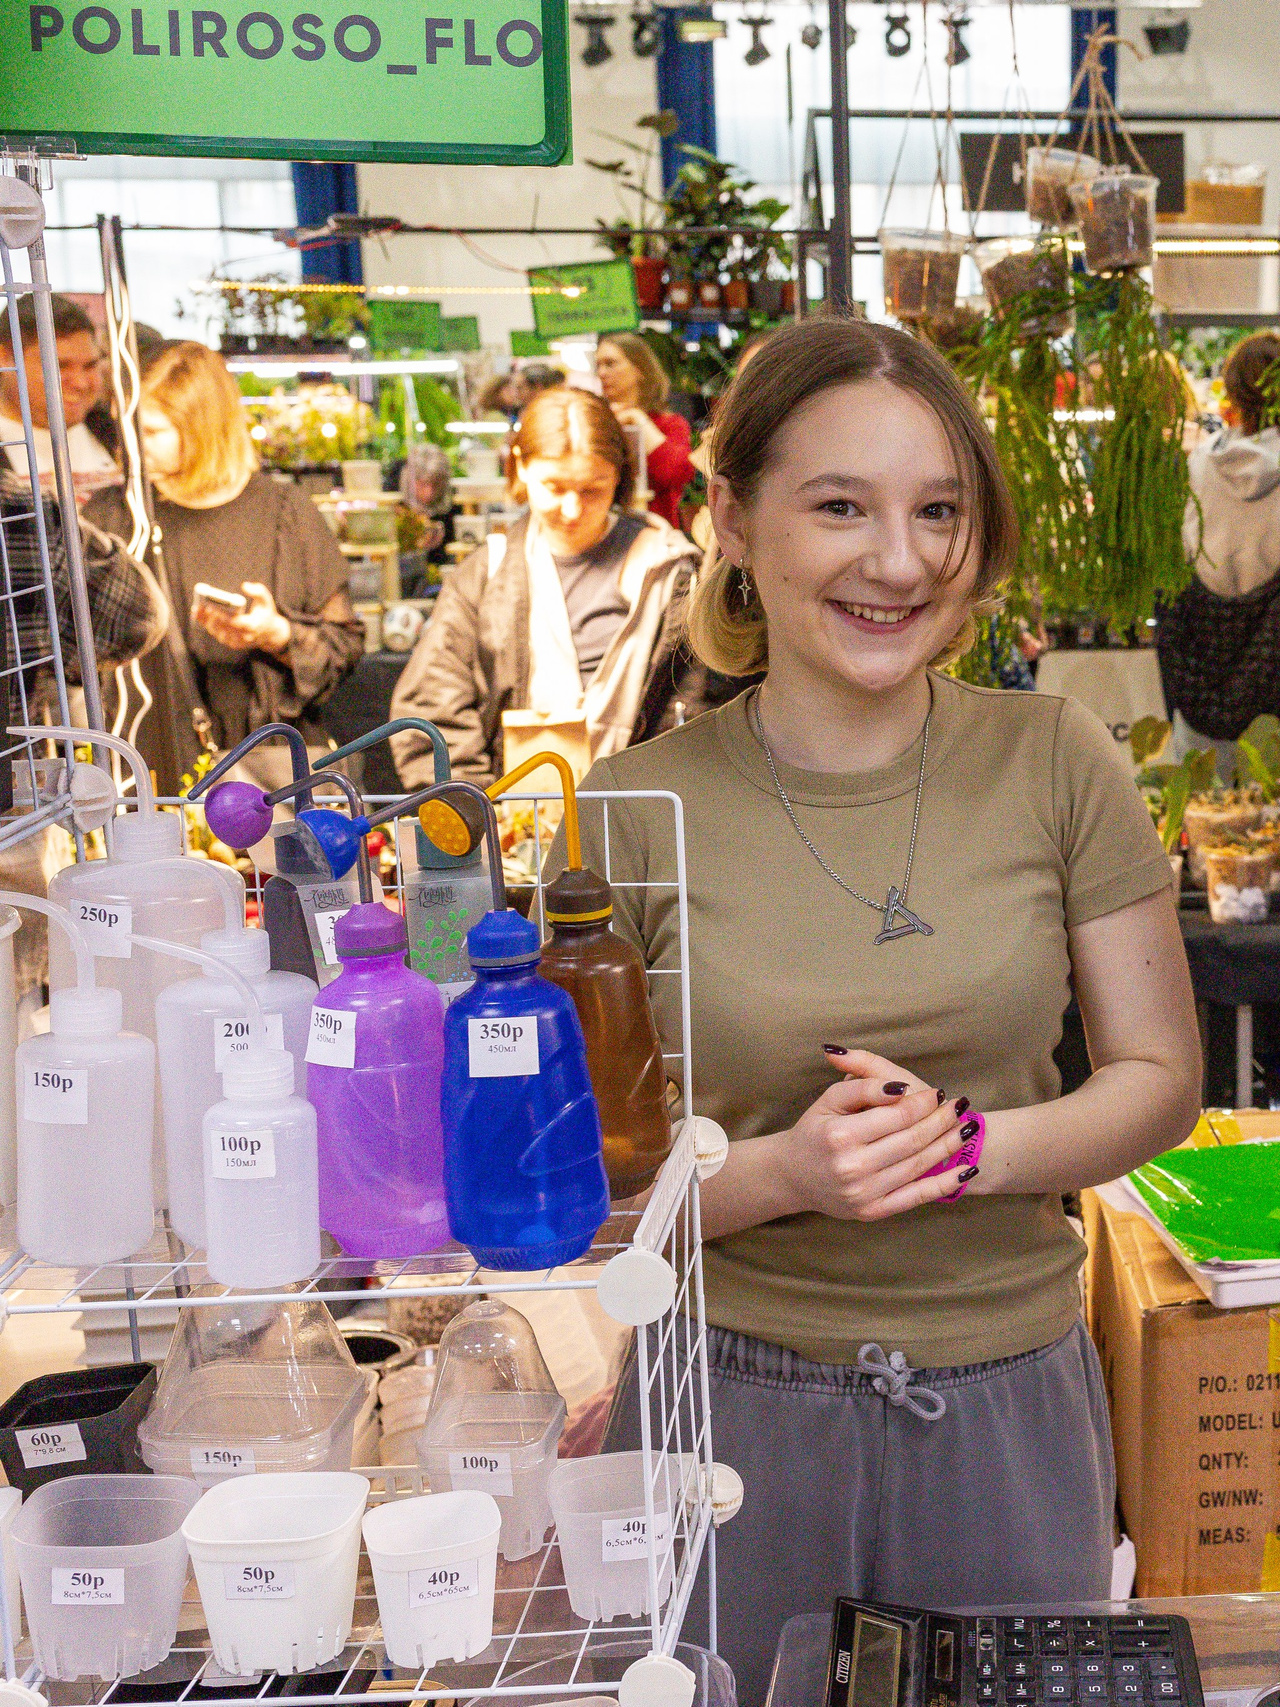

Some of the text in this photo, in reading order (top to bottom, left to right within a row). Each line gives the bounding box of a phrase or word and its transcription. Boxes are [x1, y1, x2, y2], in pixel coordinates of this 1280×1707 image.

[29, 5, 543, 75] POLIROSO_FLO
[80, 905, 119, 928] 250р
[313, 1012, 343, 1032] 350р
[480, 1022, 523, 1042] 350р
[488, 1044, 516, 1053] 450мл
[33, 1071, 74, 1093] 150р
[220, 1136, 261, 1155] 100р
[225, 1157, 257, 1168] 150мл
[1199, 1413, 1263, 1433] MODEL:
[31, 1433, 62, 1447] 60р
[203, 1451, 243, 1467] 150р
[460, 1456, 499, 1472] 100р
[1199, 1451, 1249, 1471] QNTY:
[1199, 1488, 1263, 1508] GW/NW:
[1199, 1526, 1250, 1546] MEAS:
[71, 1572, 105, 1589] 50р
[243, 1567, 275, 1582] 50р
[428, 1570, 460, 1586] 40р
[836, 1649, 852, 1685] CITIZEN
